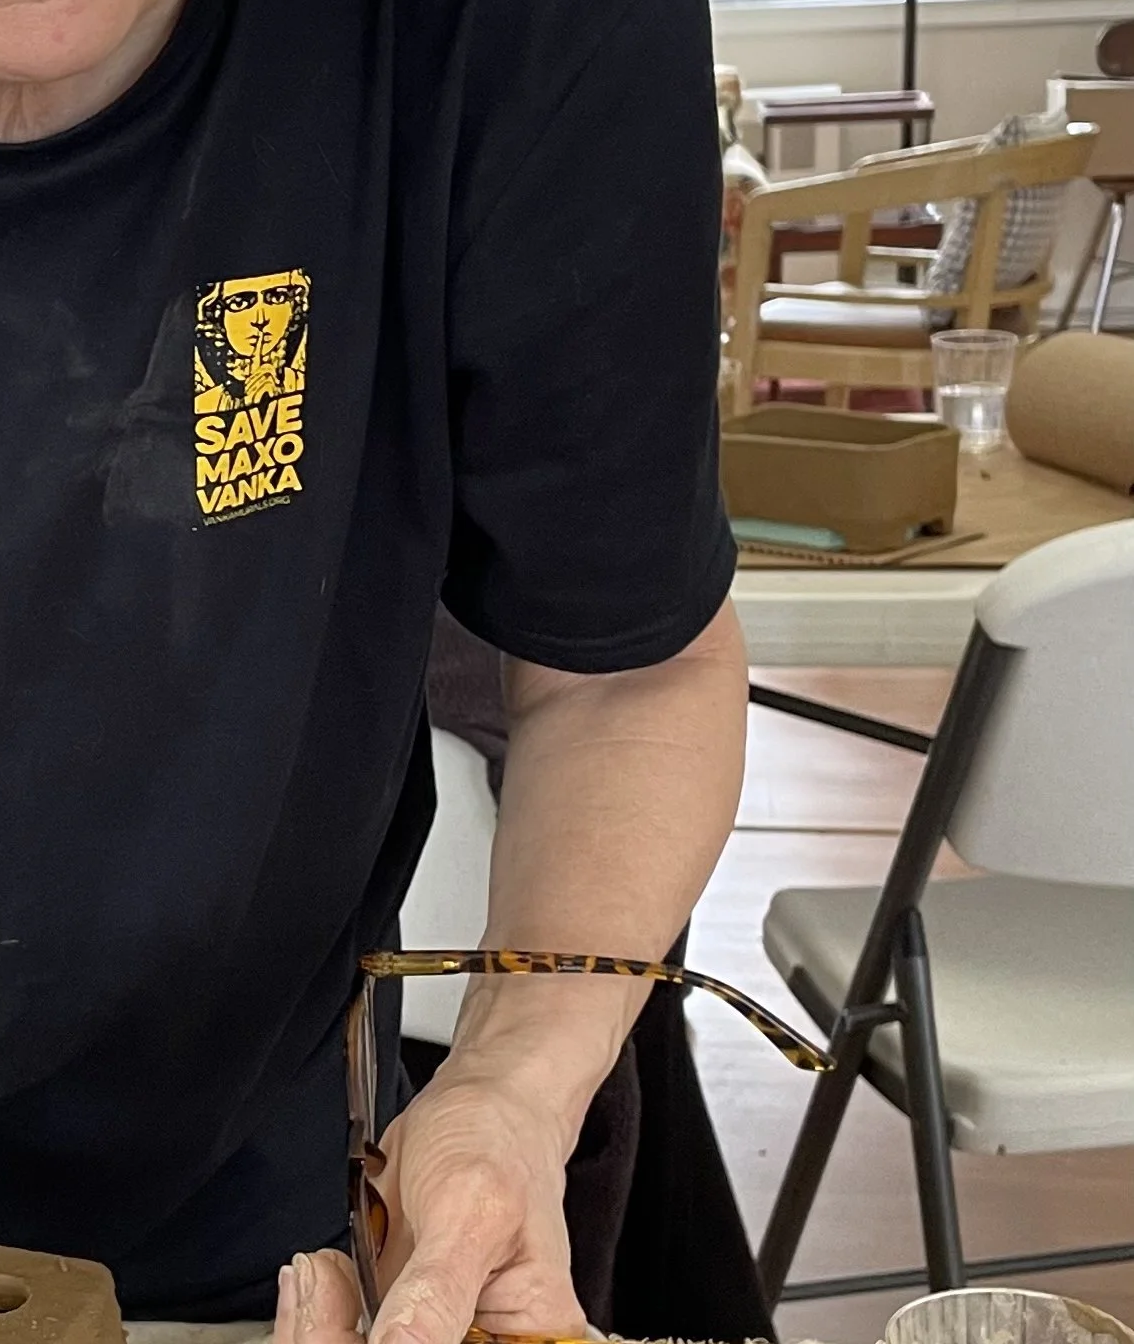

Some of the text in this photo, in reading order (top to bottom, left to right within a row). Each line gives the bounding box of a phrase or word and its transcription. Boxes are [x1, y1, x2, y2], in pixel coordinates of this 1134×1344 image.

[195, 394, 303, 455] SAVE
[196, 433, 304, 487] MAXO
[196, 465, 302, 514] VANKA
